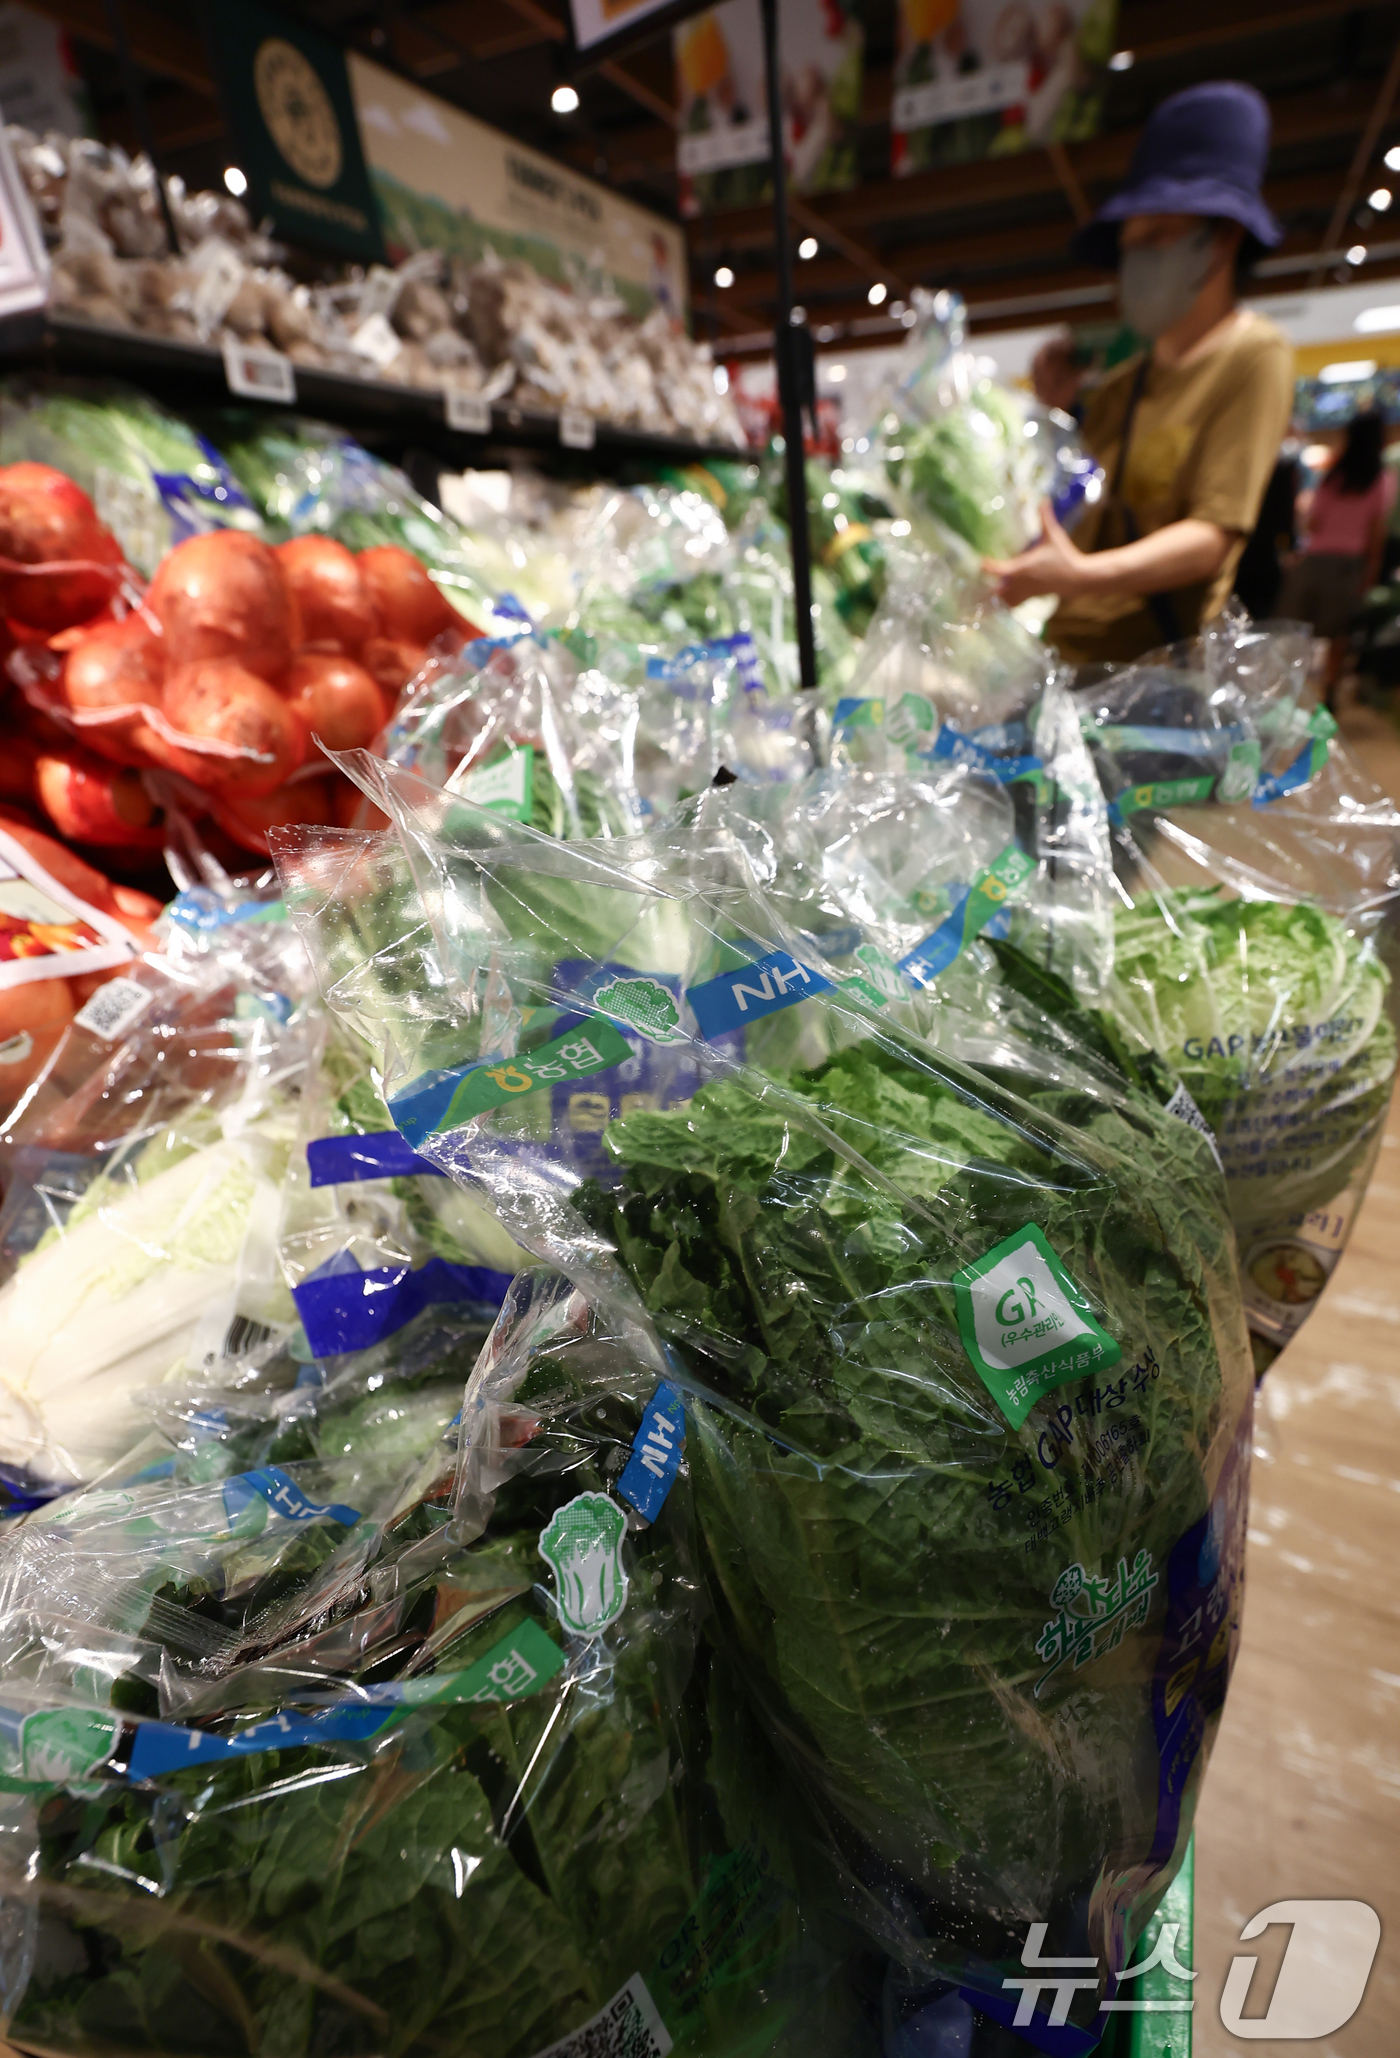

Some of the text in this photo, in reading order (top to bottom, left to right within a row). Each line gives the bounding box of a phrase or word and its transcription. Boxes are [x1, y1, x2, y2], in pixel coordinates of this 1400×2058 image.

[731, 959, 811, 1011] NH
[524, 1037, 604, 1079] 농협
[1184, 1034, 1244, 1060] GAP
[995, 1277, 1045, 1327] GP
[1005, 1343, 1105, 1406] 농림축산식품부
[640, 1412, 676, 1478] NH
[986, 1345, 1160, 1511] 농협 GAP 대상 수상
[659, 1914, 700, 1971] QR
